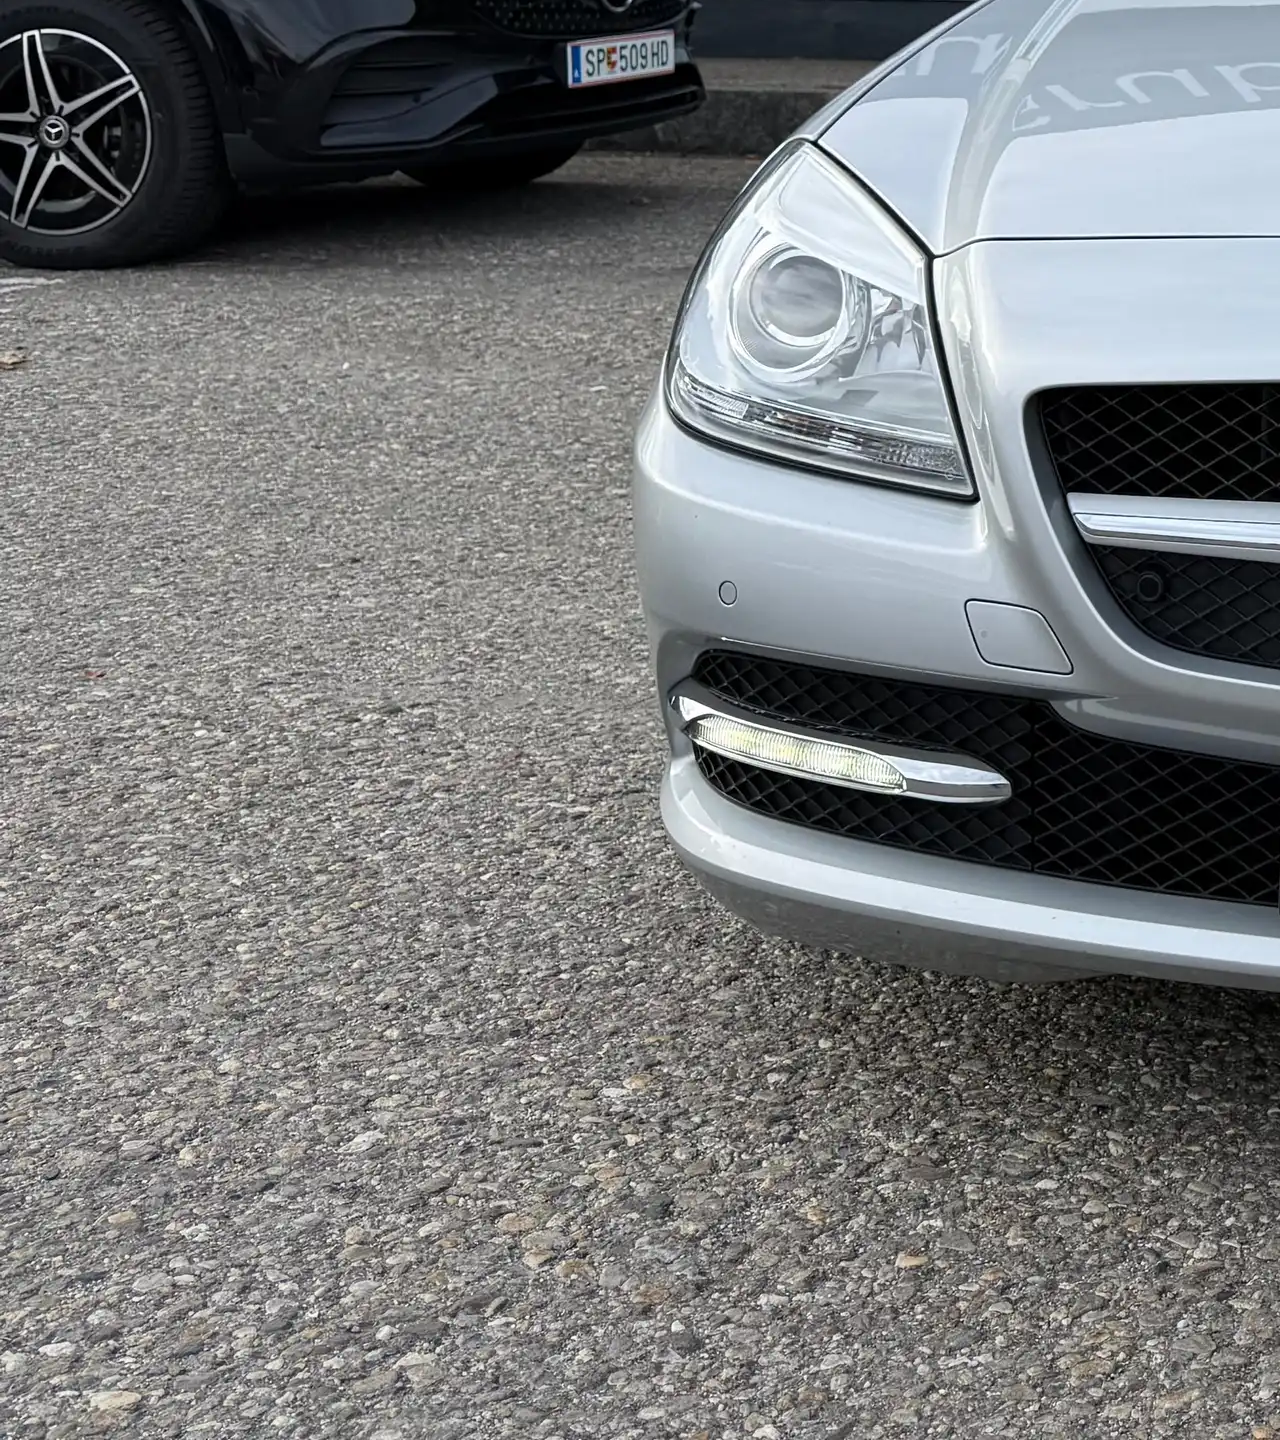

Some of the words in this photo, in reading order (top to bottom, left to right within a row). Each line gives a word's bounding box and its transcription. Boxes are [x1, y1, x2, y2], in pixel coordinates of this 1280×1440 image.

[585, 48, 606, 77] SP
[619, 43, 648, 72] 509
[650, 40, 669, 68] HD
